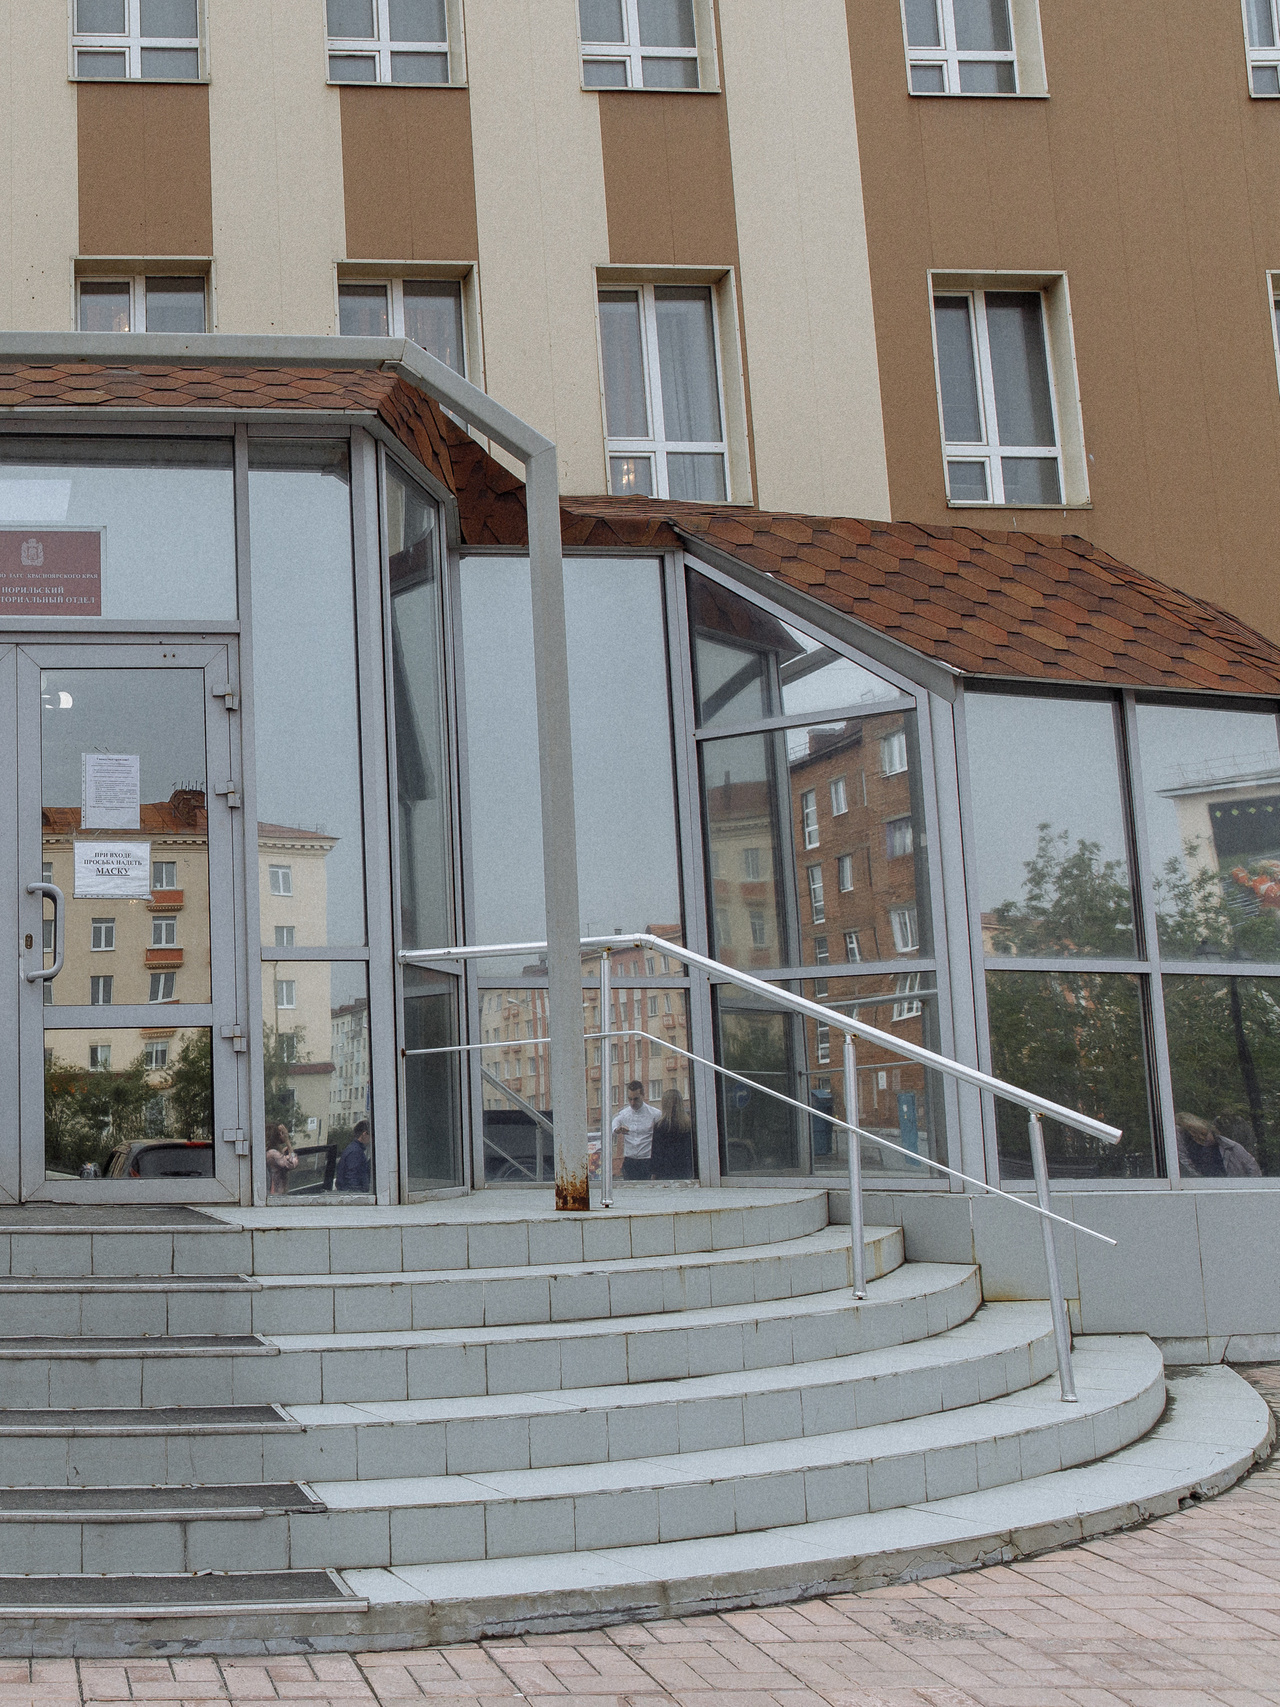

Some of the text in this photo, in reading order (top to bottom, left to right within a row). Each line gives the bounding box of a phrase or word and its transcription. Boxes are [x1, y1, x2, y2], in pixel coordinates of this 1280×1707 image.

[1, 586, 64, 594] НОРИЛЬСКИЙ
[65, 596, 95, 604] ОТДЕЛ
[96, 867, 130, 875] МАСКУ
